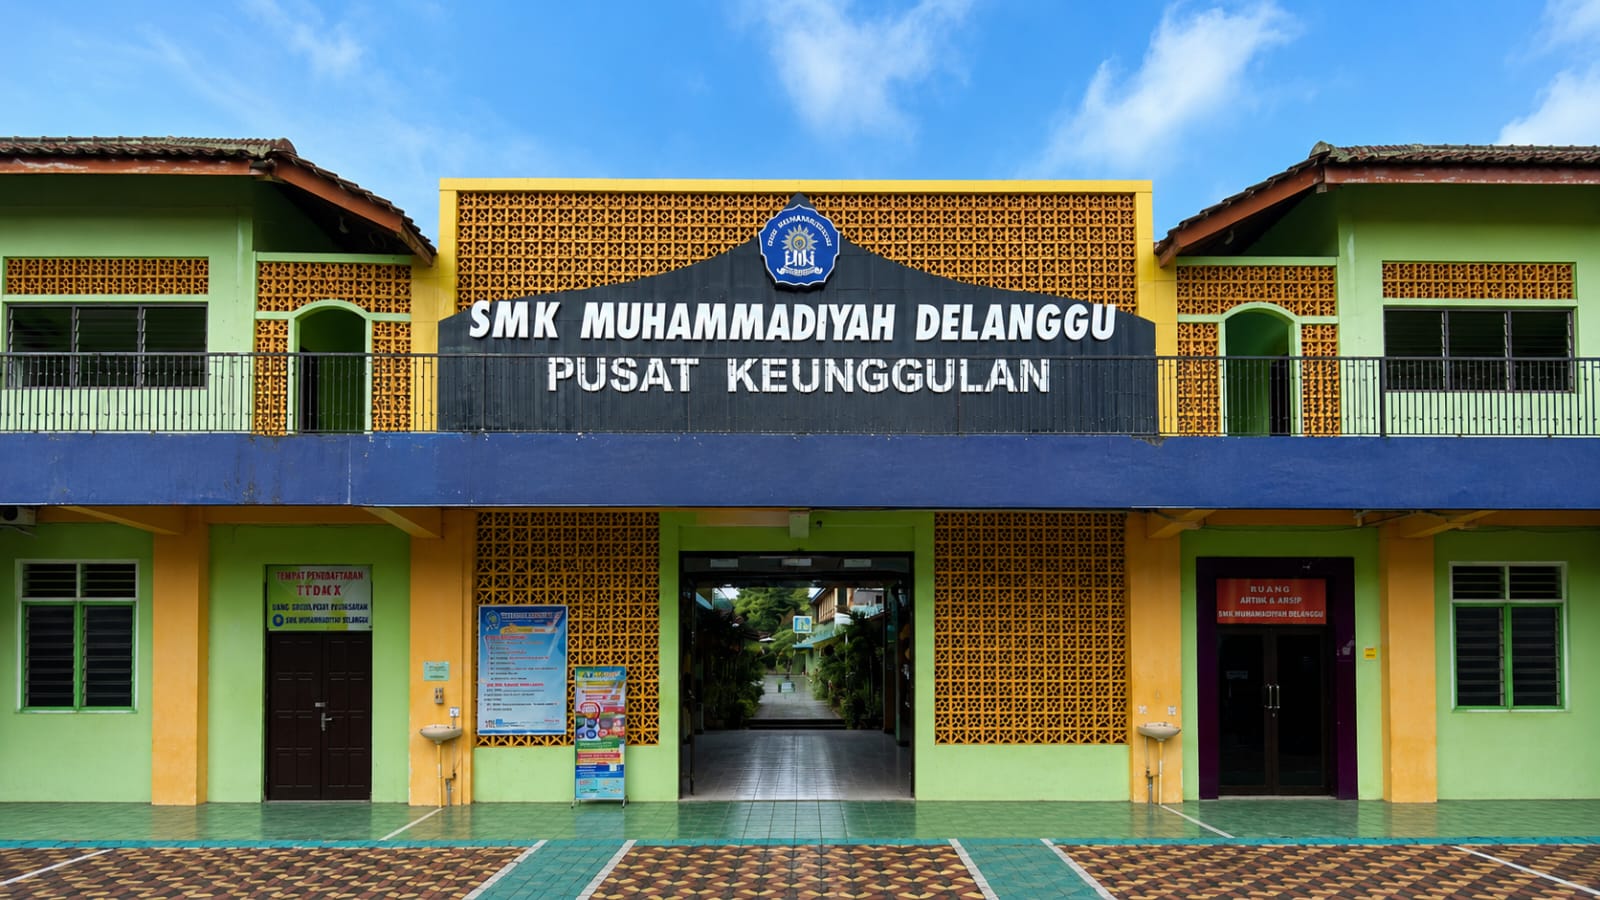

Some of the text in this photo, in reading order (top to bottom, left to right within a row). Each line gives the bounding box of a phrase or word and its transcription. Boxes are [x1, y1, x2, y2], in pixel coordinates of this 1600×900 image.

[469, 300, 1116, 341] SMK MUHAMMADIYAH DELANGGU
[547, 357, 1050, 393] PUSAT KEUNGGULAN
[1250, 585, 1291, 593] RUANG
